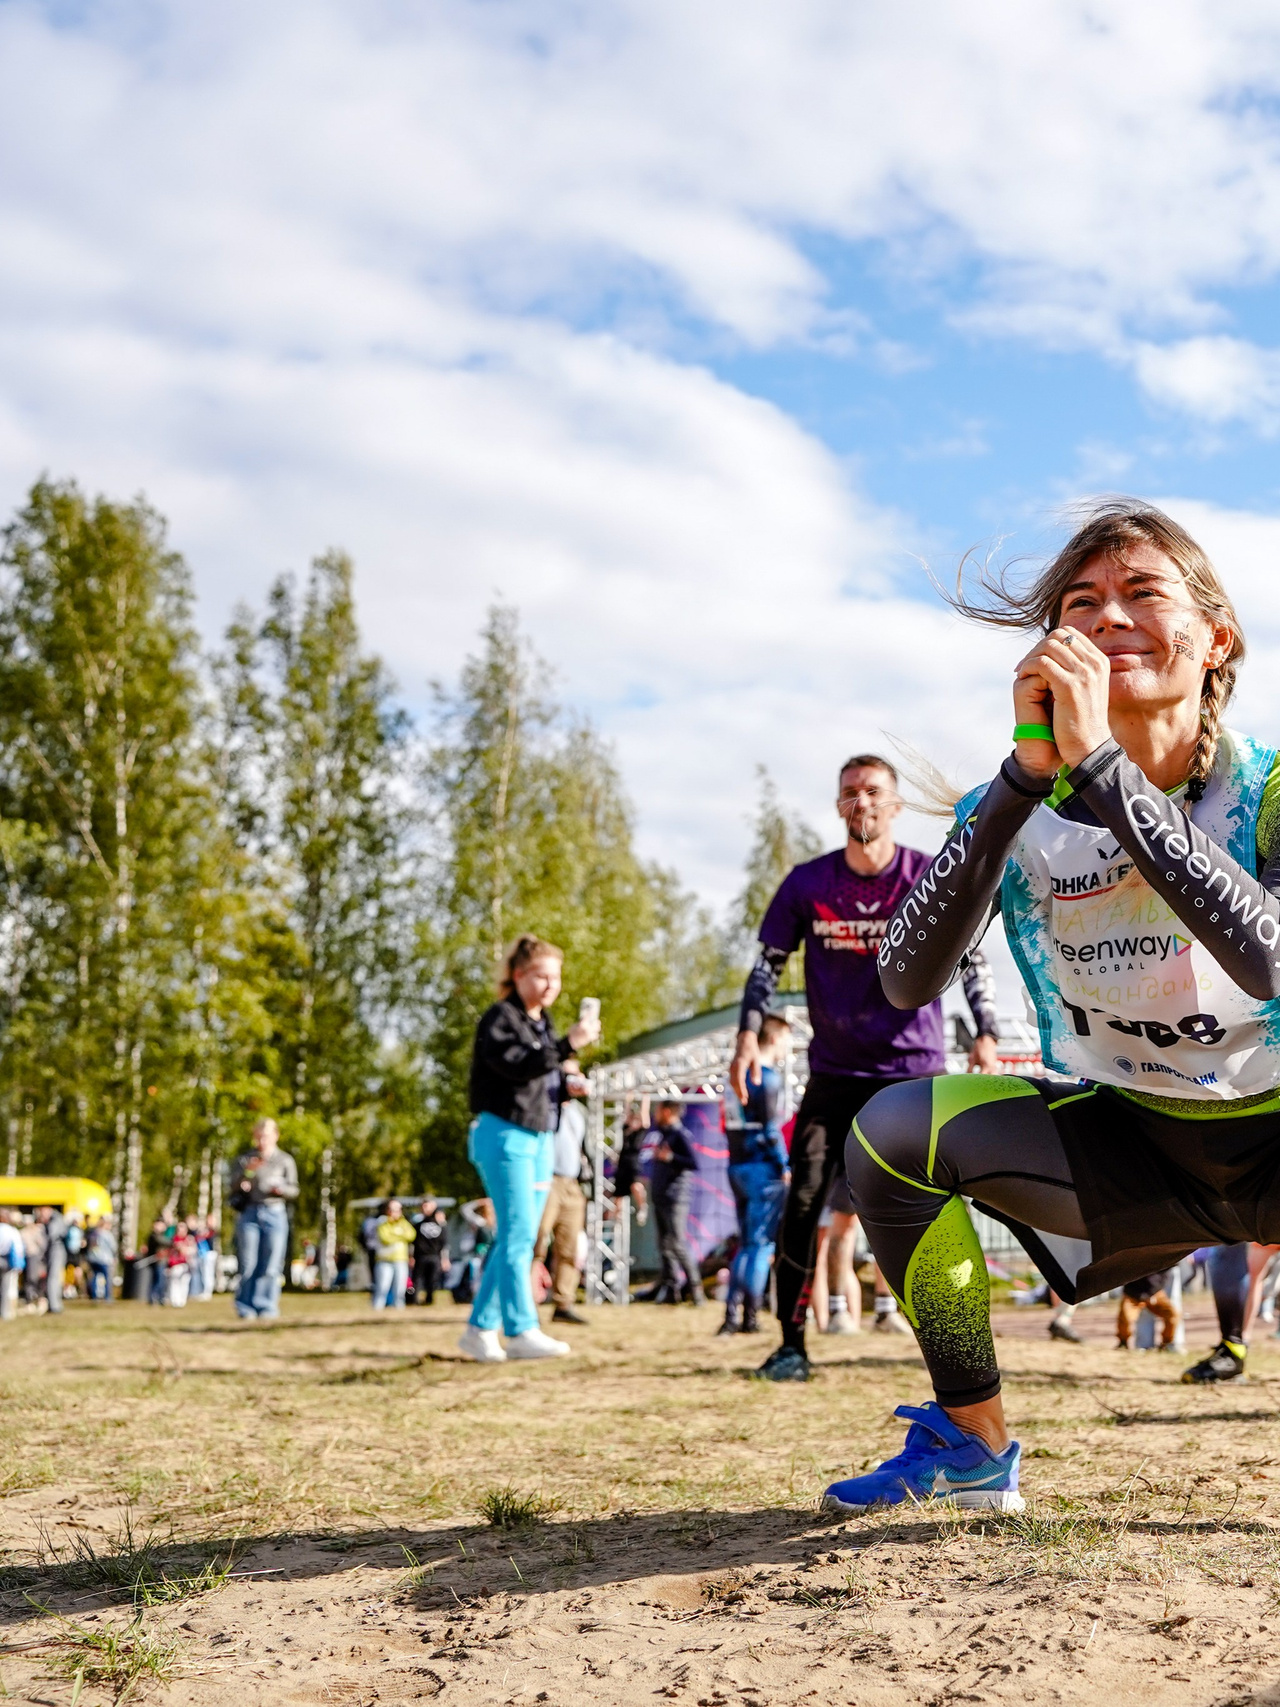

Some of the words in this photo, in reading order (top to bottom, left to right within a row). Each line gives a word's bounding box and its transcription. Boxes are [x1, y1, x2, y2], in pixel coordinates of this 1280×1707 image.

[877, 829, 966, 976] eenway
[1050, 871, 1102, 894] ОНКА
[896, 888, 956, 972] GLOBAL
[1165, 871, 1247, 953] GLOBAL
[1053, 934, 1172, 962] reenway
[1073, 962, 1145, 976] GLOBAL
